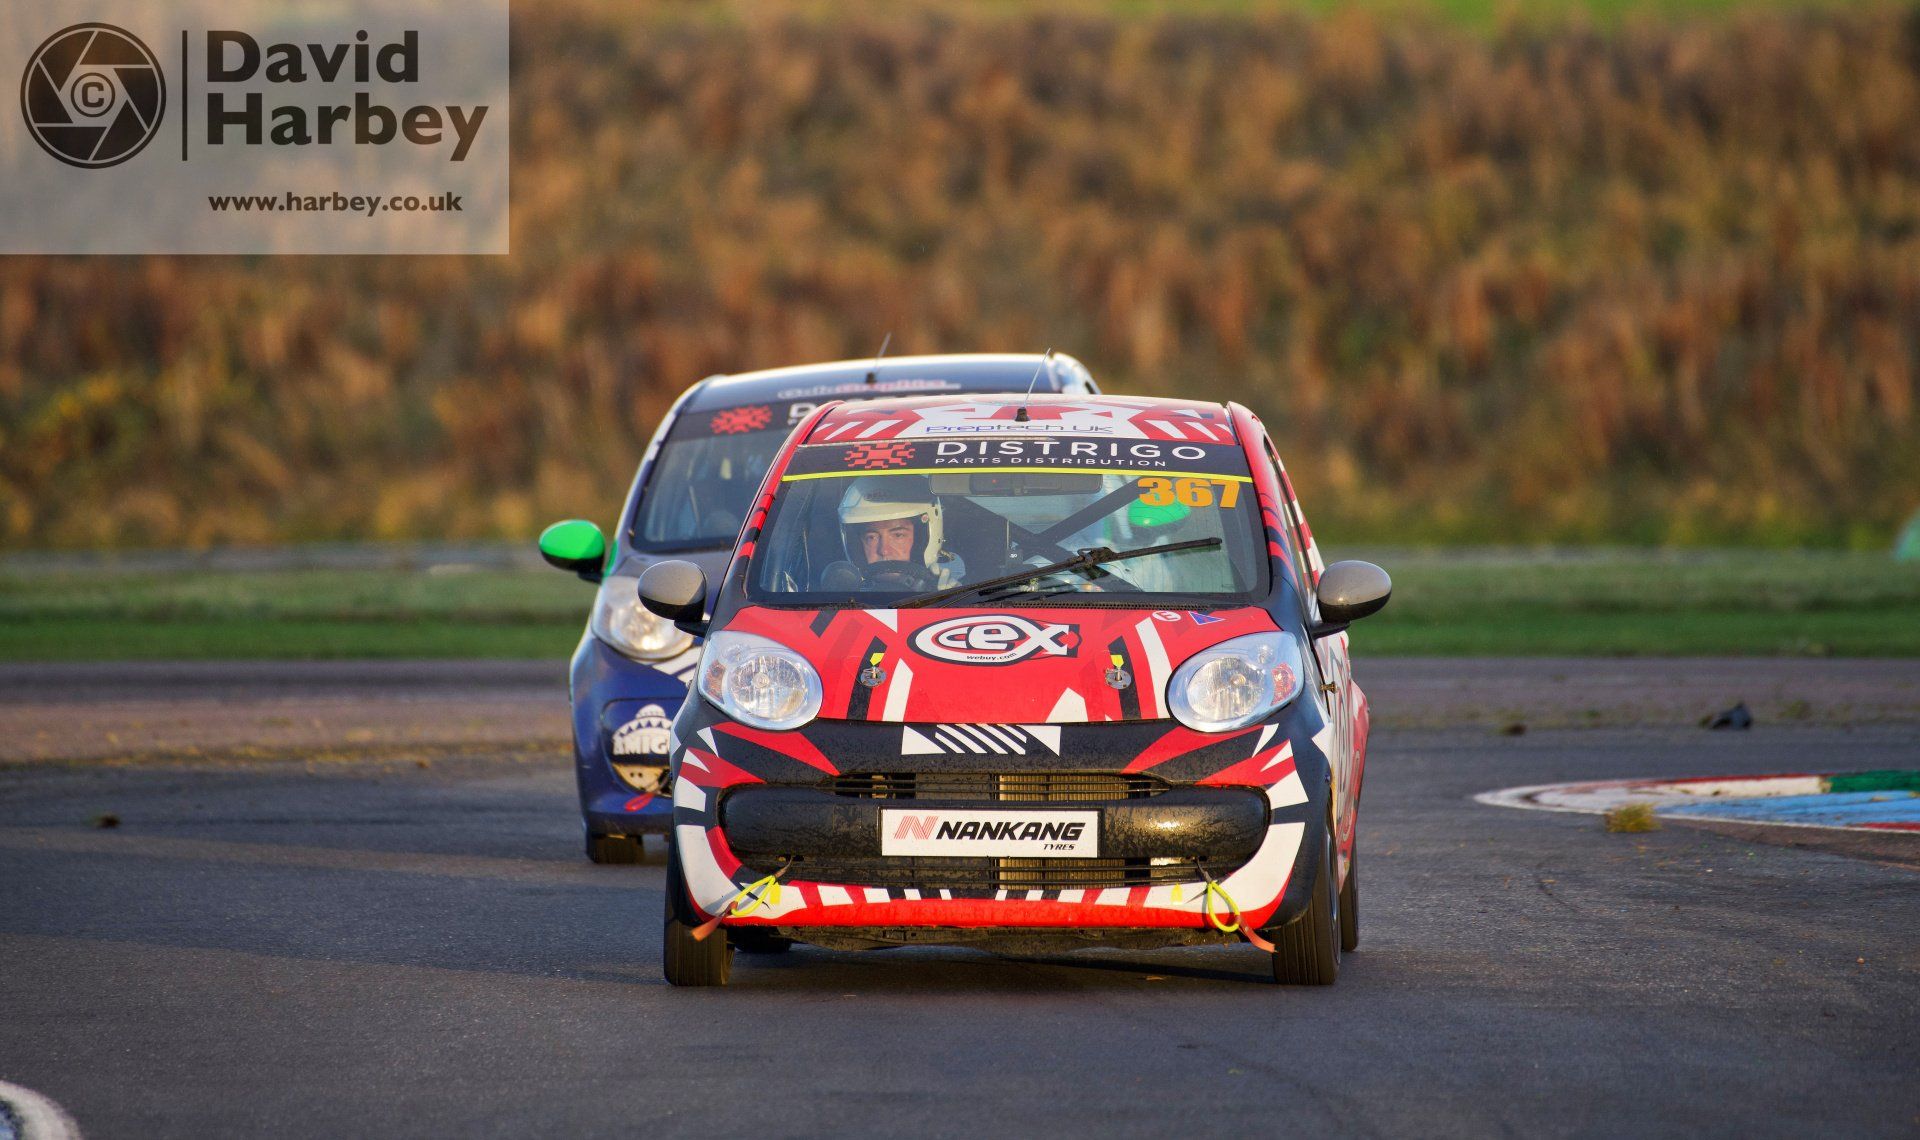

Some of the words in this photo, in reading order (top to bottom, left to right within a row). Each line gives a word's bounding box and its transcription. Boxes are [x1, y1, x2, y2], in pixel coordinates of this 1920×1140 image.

[936, 441, 1206, 460] DISTRIGO
[1011, 457, 1166, 467] DISTRIBUTION
[1137, 477, 1240, 508] 367
[966, 651, 1017, 661] webuy.com
[612, 732, 670, 755] AMIG
[935, 821, 1086, 841] NANKANG
[1043, 843, 1075, 851] TYRES
